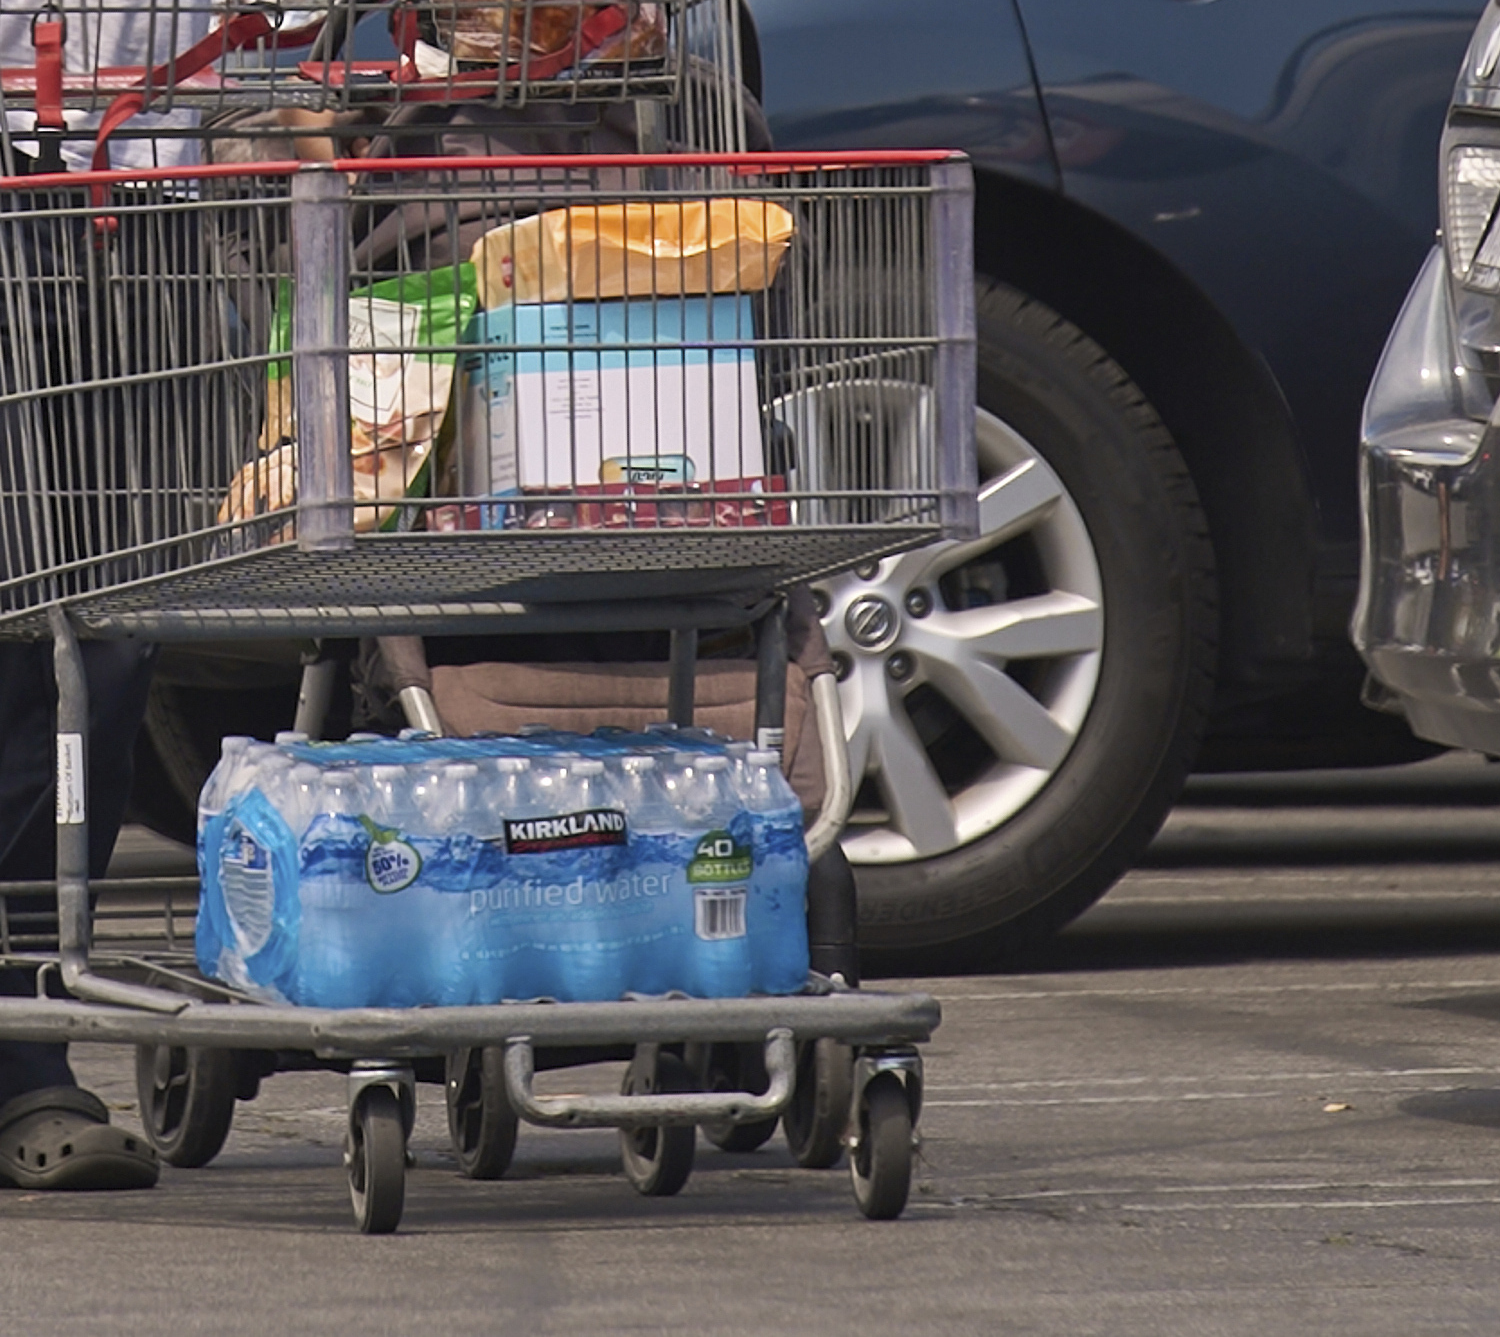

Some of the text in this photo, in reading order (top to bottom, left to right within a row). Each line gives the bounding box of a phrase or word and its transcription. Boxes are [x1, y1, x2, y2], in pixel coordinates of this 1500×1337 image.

[509, 813, 625, 841] KIRKLAND
[697, 838, 733, 858] 40
[470, 875, 583, 916] purified
[594, 874, 672, 904] water
